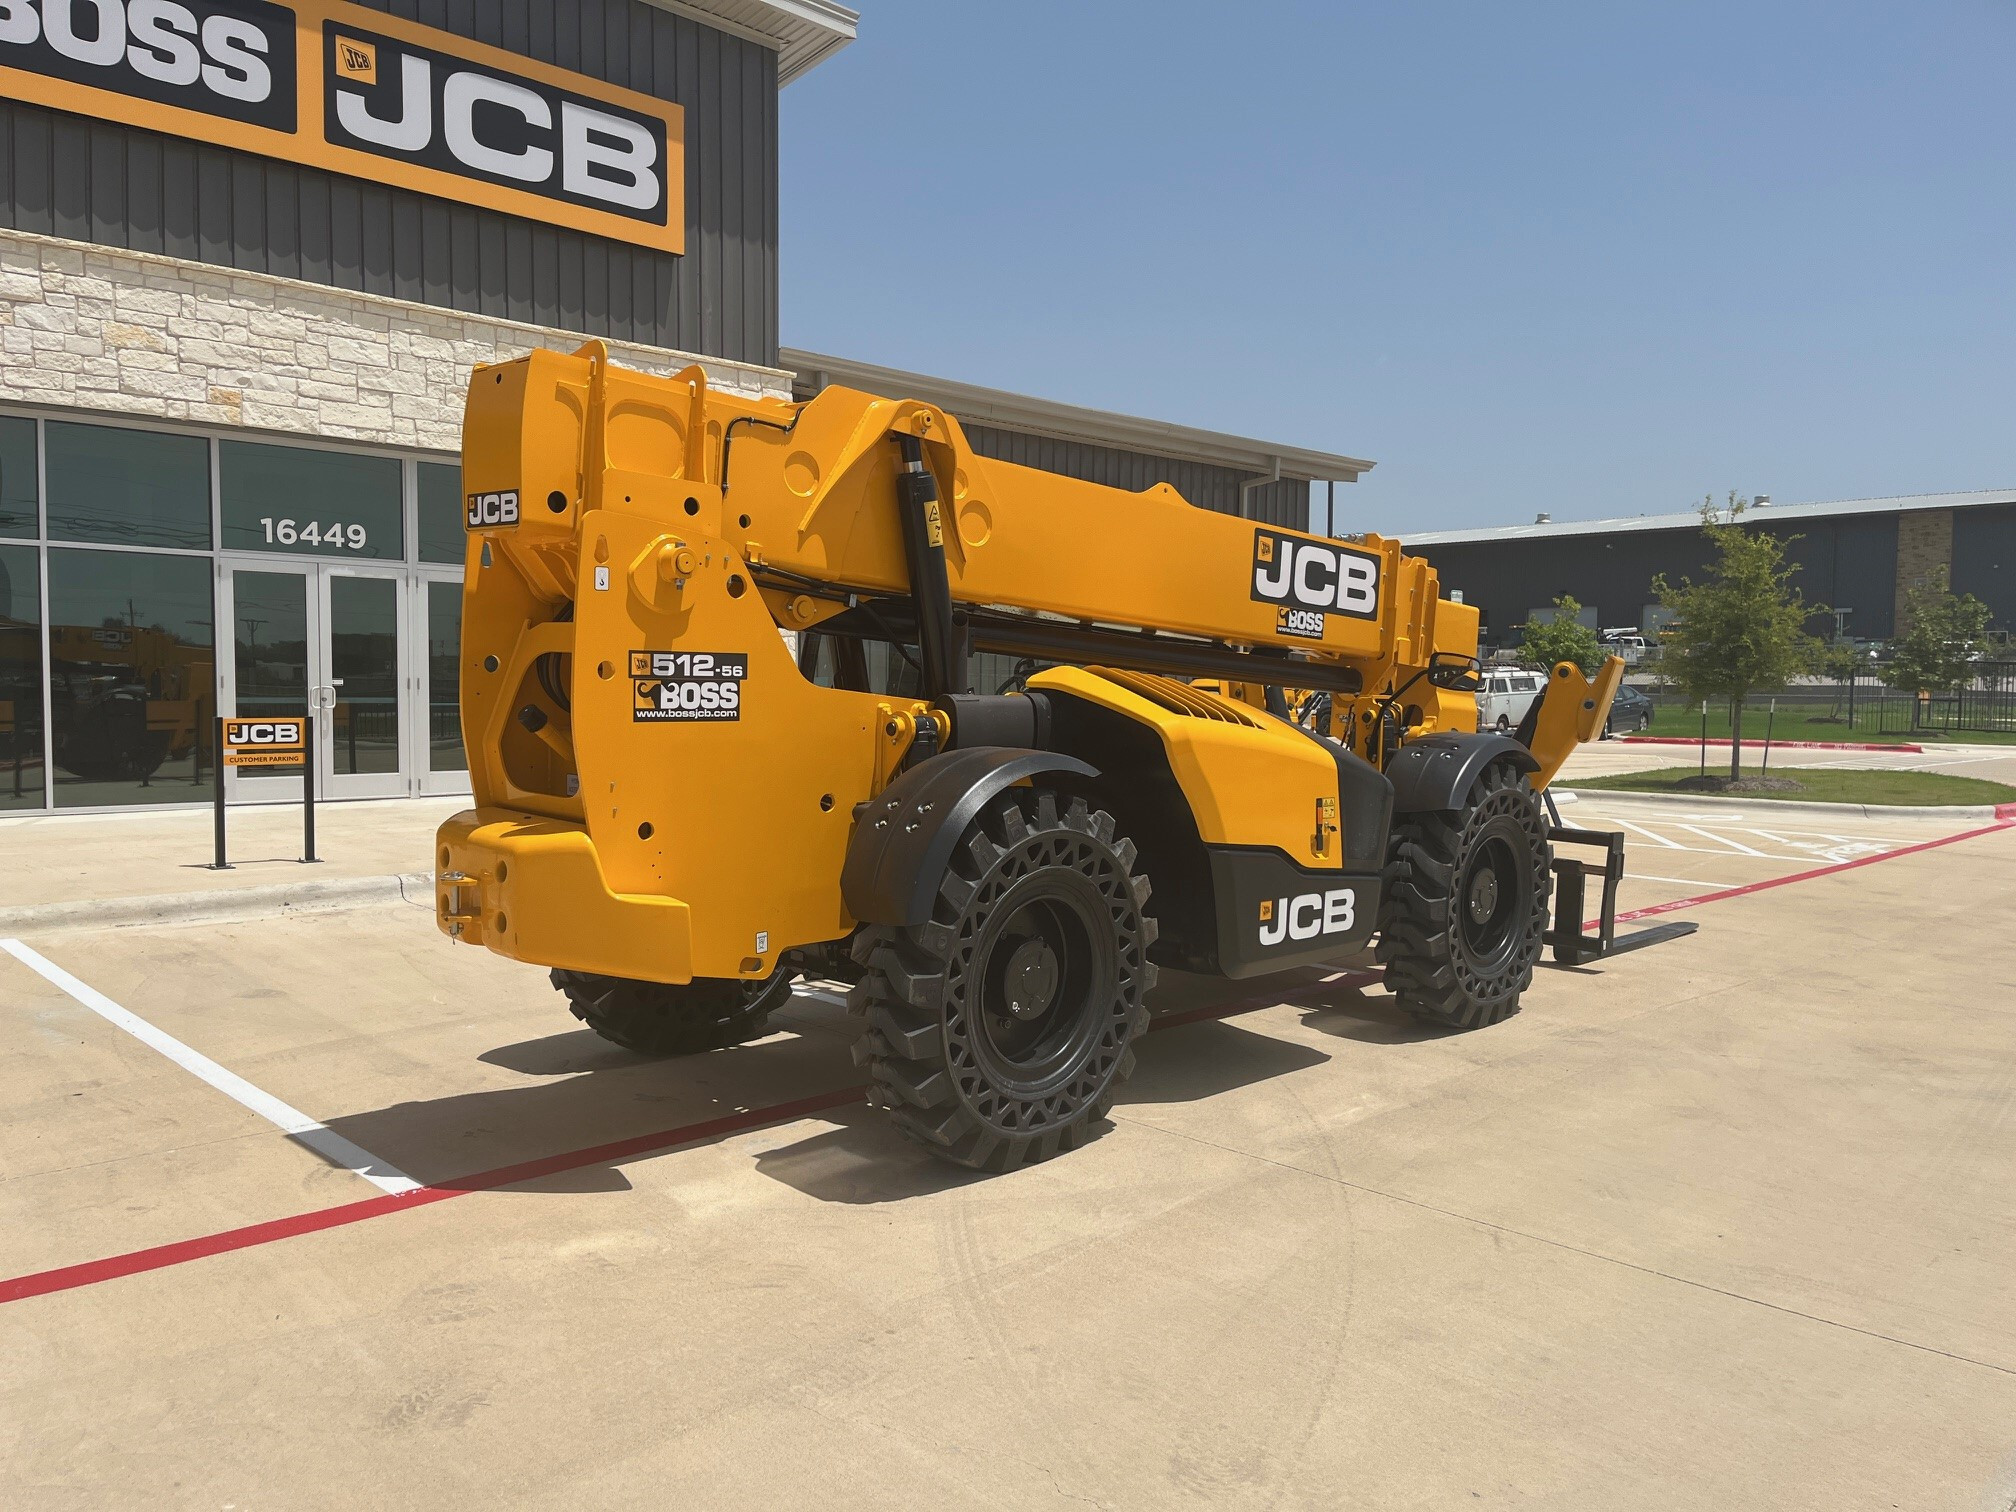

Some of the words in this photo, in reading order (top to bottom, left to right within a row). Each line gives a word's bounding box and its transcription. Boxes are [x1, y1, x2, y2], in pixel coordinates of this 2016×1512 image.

[0, 0, 271, 102] OSS
[346, 48, 370, 69] JCB
[336, 52, 660, 210] JCB
[469, 492, 518, 525] JCB
[260, 517, 367, 549] 16449
[1256, 540, 1377, 614] JCB
[1277, 626, 1323, 638] www.bossjcb.com
[1288, 610, 1324, 632] BOSS
[652, 653, 743, 677] 512-56
[660, 681, 739, 710] BOSS
[636, 709, 737, 719] www.bossjcb.com
[229, 724, 299, 743] JCB
[1259, 888, 1355, 946] JCB
